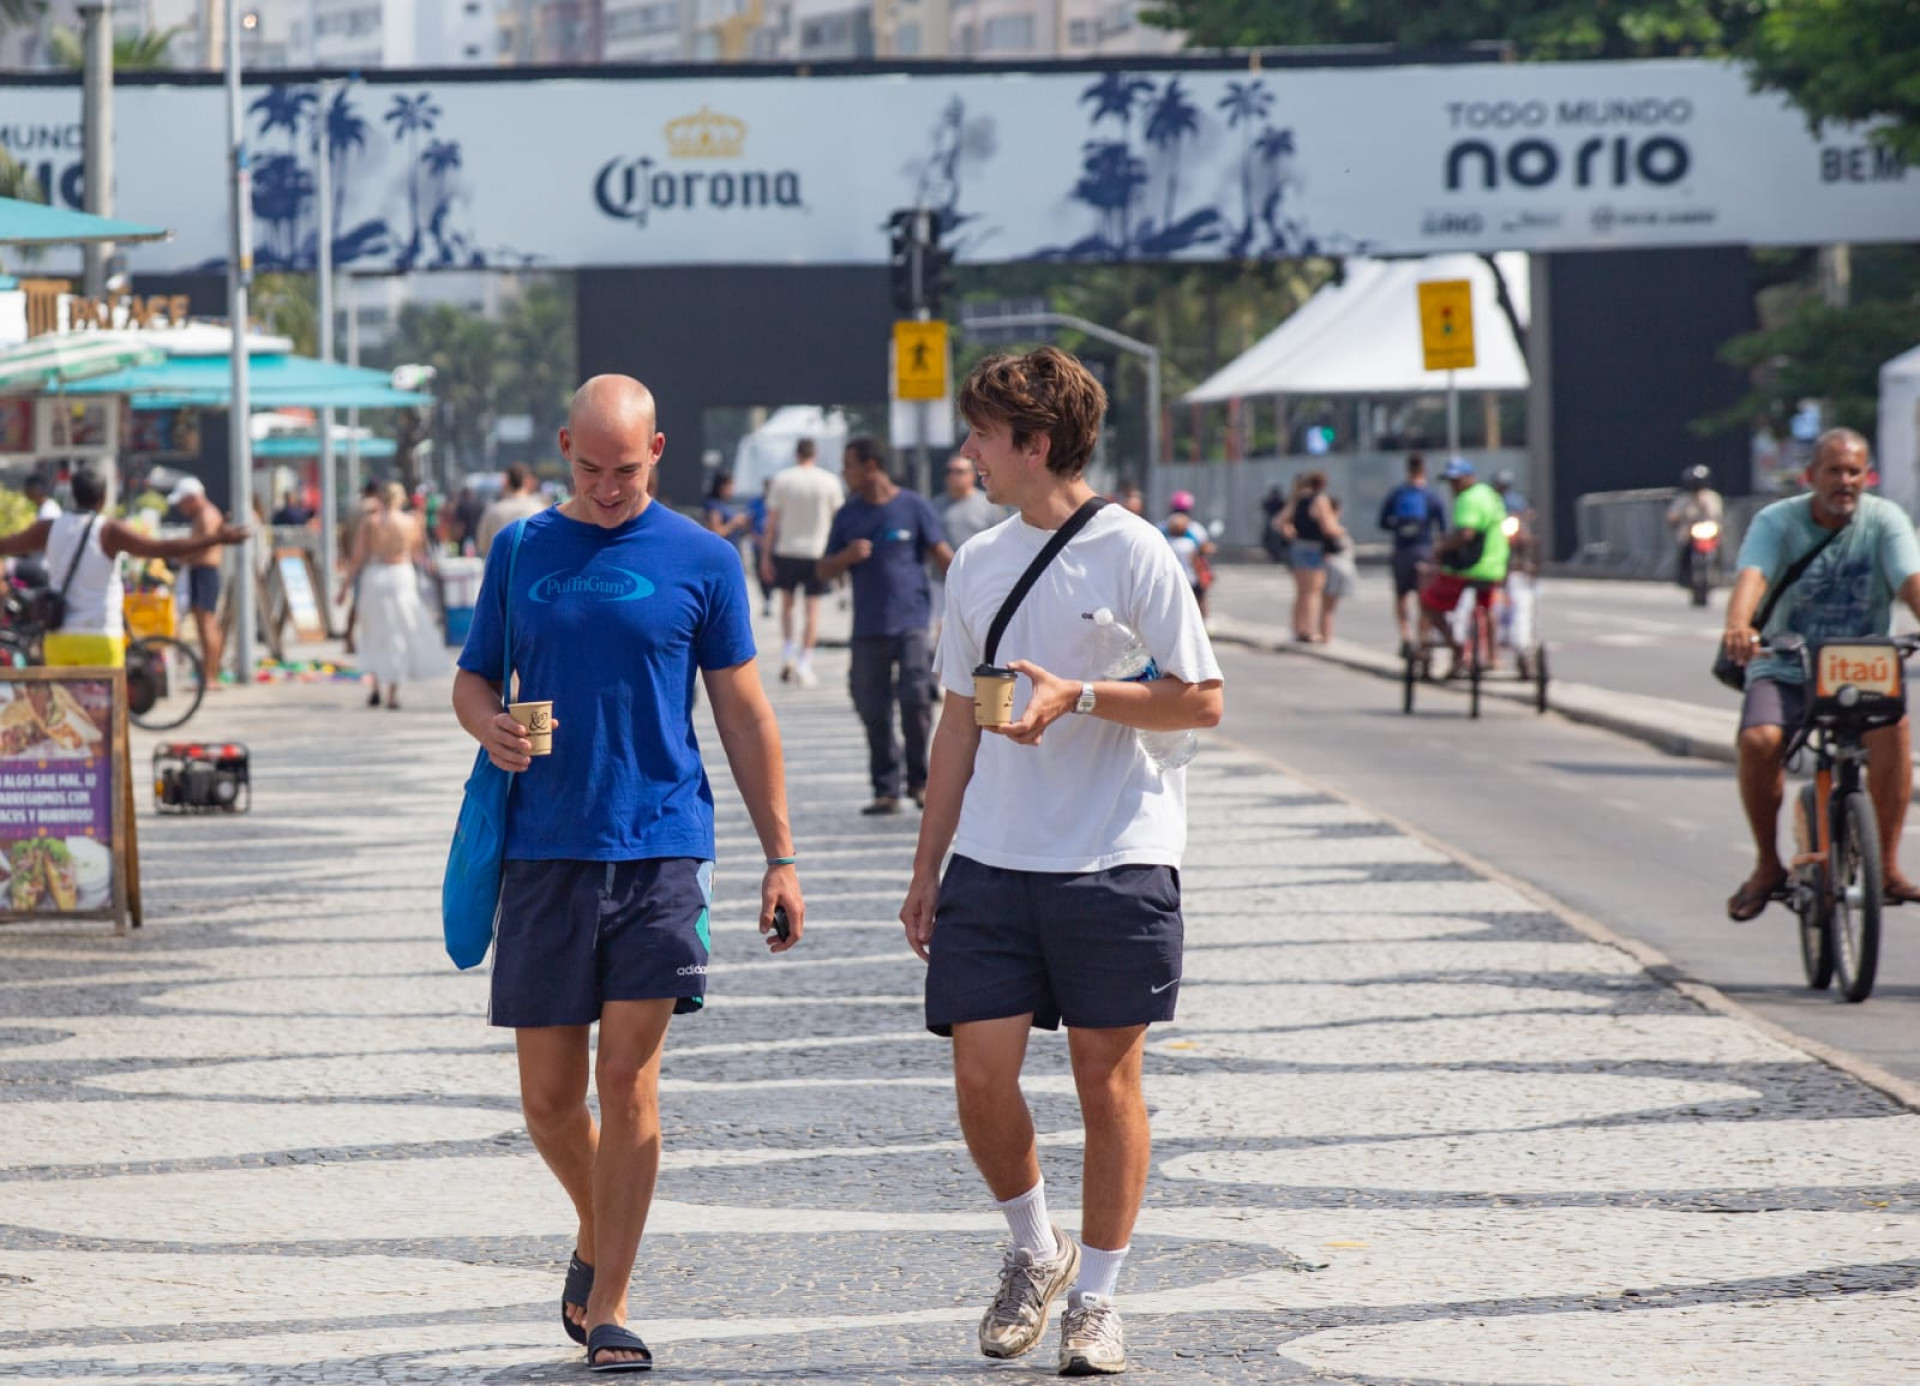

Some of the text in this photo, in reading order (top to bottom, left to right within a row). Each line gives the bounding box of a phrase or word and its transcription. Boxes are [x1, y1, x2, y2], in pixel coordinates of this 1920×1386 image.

[1446, 98, 1693, 128] TODO MUNDO
[0, 124, 85, 150] UND
[594, 154, 803, 229] Corona
[1829, 655, 1888, 682] itaú
[0, 809, 26, 823] ACOS
[676, 964, 708, 976] adida
